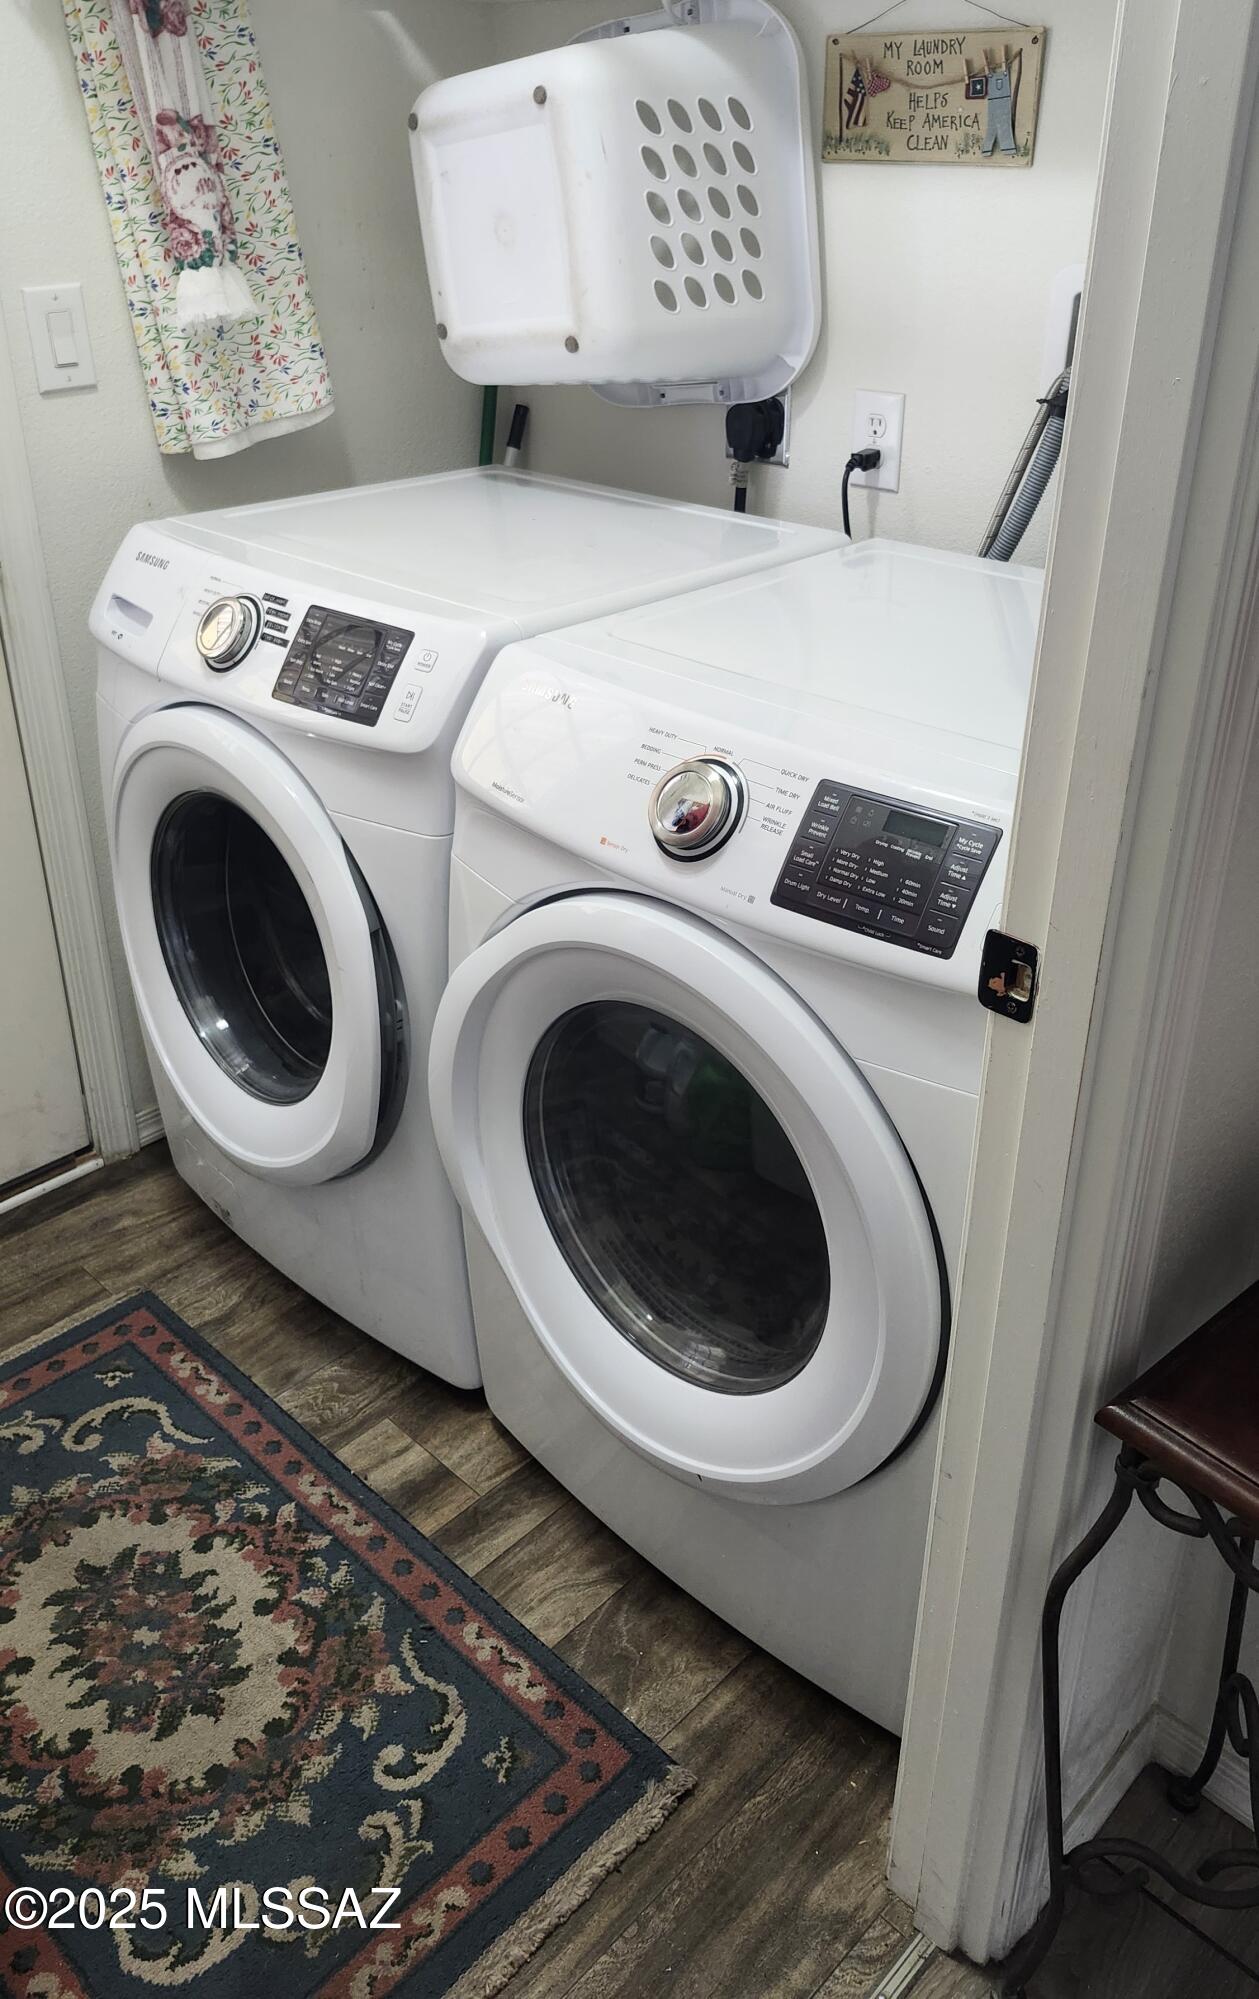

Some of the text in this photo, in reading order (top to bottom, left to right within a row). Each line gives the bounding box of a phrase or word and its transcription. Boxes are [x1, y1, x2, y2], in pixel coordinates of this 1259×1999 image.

[883, 36, 967, 59] MY LAUNDRY
[906, 58, 944, 76] ROOM
[909, 92, 949, 111] HELPS
[886, 111, 981, 131] KEEP AMERICA
[906, 133, 950, 151] CLEAN
[135, 551, 170, 570] SAMSUNG
[648, 727, 677, 740] HEAVY DUTY
[640, 743, 662, 754] BEDDING
[714, 746, 734, 756] NORMAL
[633, 758, 662, 772] PERM PRESS
[627, 773, 650, 785] DELICATES
[780, 768, 809, 783] QUICK DRY
[775, 787, 800, 800] TIME DRY
[765, 802, 792, 816] AIR FLUFF
[817, 801, 830, 810] Load
[762, 816, 787, 829] WRINKLE
[811, 821, 830, 832] Wrinkle
[760, 824, 784, 836] RELEASE
[808, 828, 827, 839] Prevent
[958, 837, 983, 849] My Cycle
[793, 855, 805, 864] Load
[800, 850, 814, 859] Small
[840, 849, 861, 860] Very Dry
[836, 858, 858, 870] More Dry
[873, 859, 885, 867] High
[950, 863, 969, 874] Adjust
[832, 867, 859, 880] Normal Dry
[869, 867, 889, 878] Medium
[948, 870, 962, 880] Time
[784, 877, 811, 892] Drum Light
[829, 876, 852, 888] Damp Dry
[865, 877, 876, 885] Low
[904, 879, 921, 889] 60min
[816, 891, 841, 904] Dry Level
[861, 886, 886, 898] Extra Low
[901, 889, 918, 898] 40min
[940, 892, 958, 903] Adjust
[937, 899, 952, 908] Time
[891, 914, 905, 924] Time
[927, 924, 945, 935] Sound
